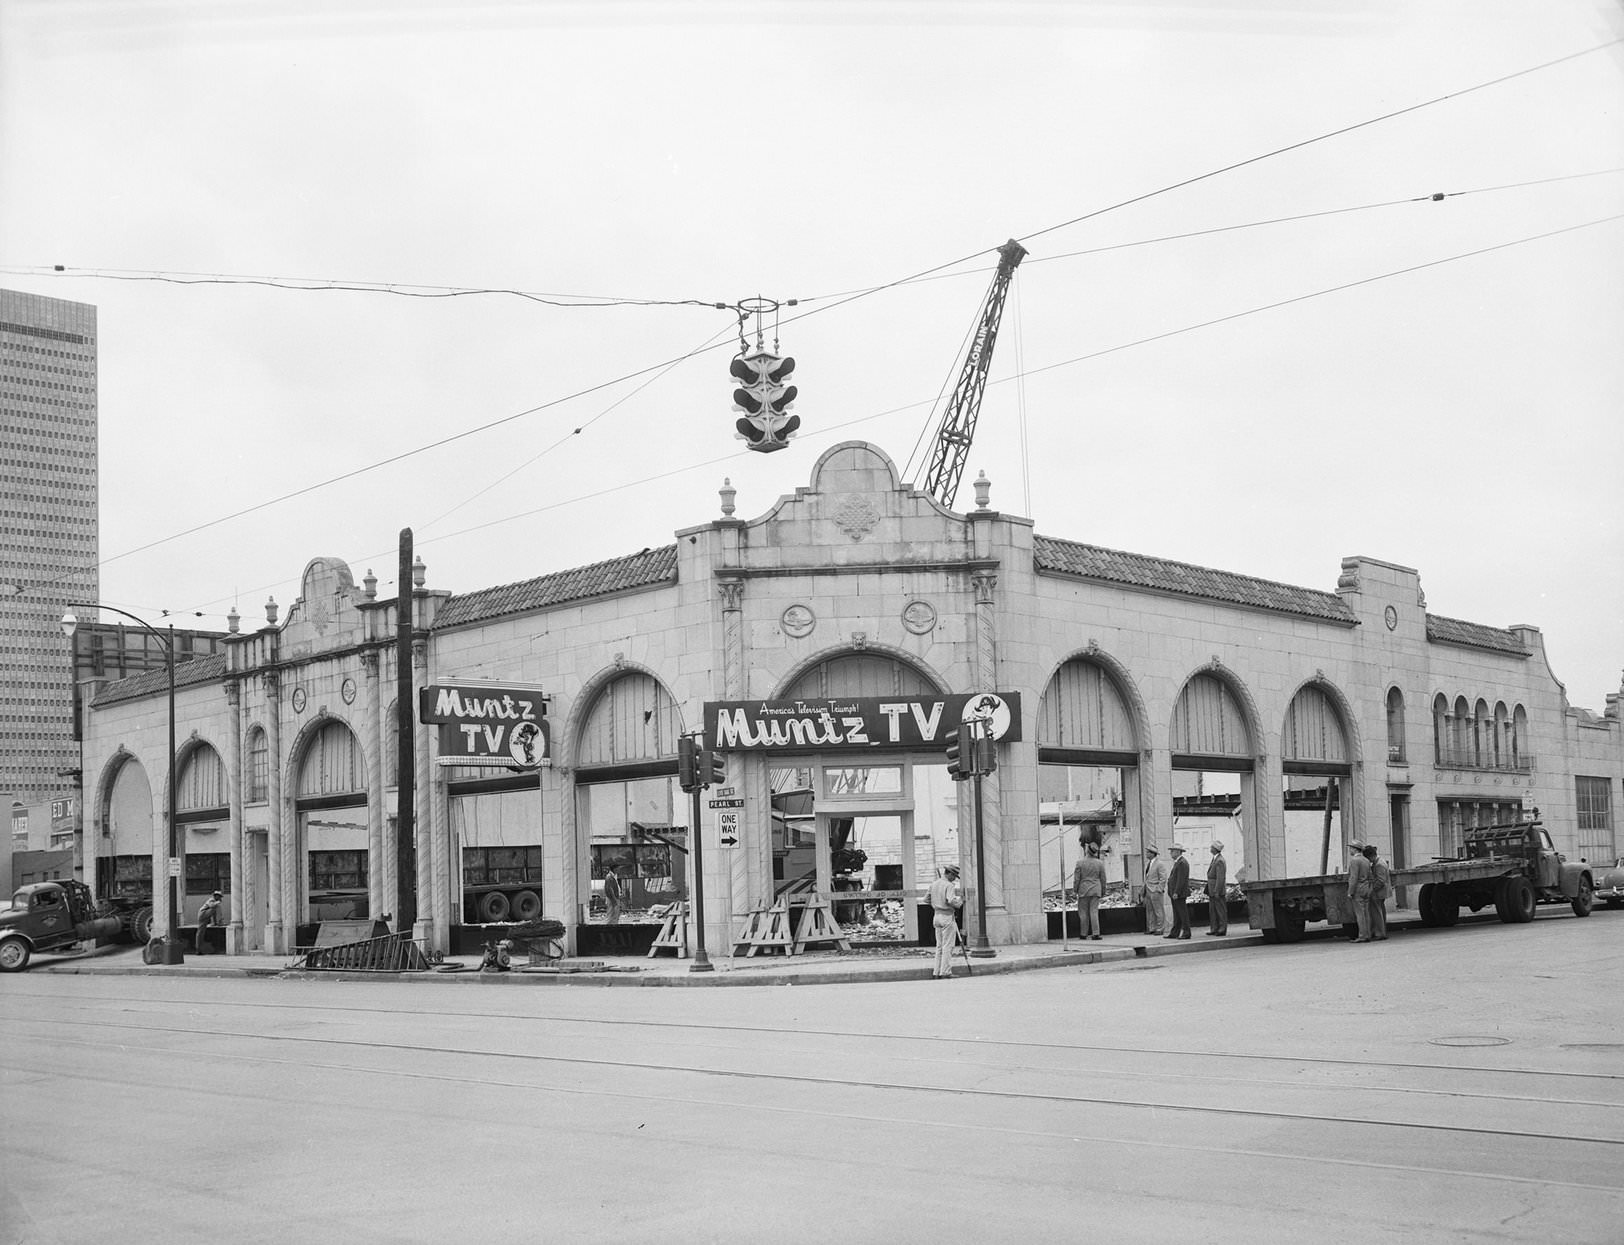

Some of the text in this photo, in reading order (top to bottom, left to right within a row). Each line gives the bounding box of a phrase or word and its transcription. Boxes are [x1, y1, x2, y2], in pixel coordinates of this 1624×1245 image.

[968, 326, 988, 366] LORAIN
[435, 689, 536, 720] Muntz
[795, 701, 828, 714] Television
[460, 723, 505, 753] TV
[716, 702, 945, 748] Muntz TV
[721, 814, 736, 824] ONE
[721, 825, 737, 834] WAY
